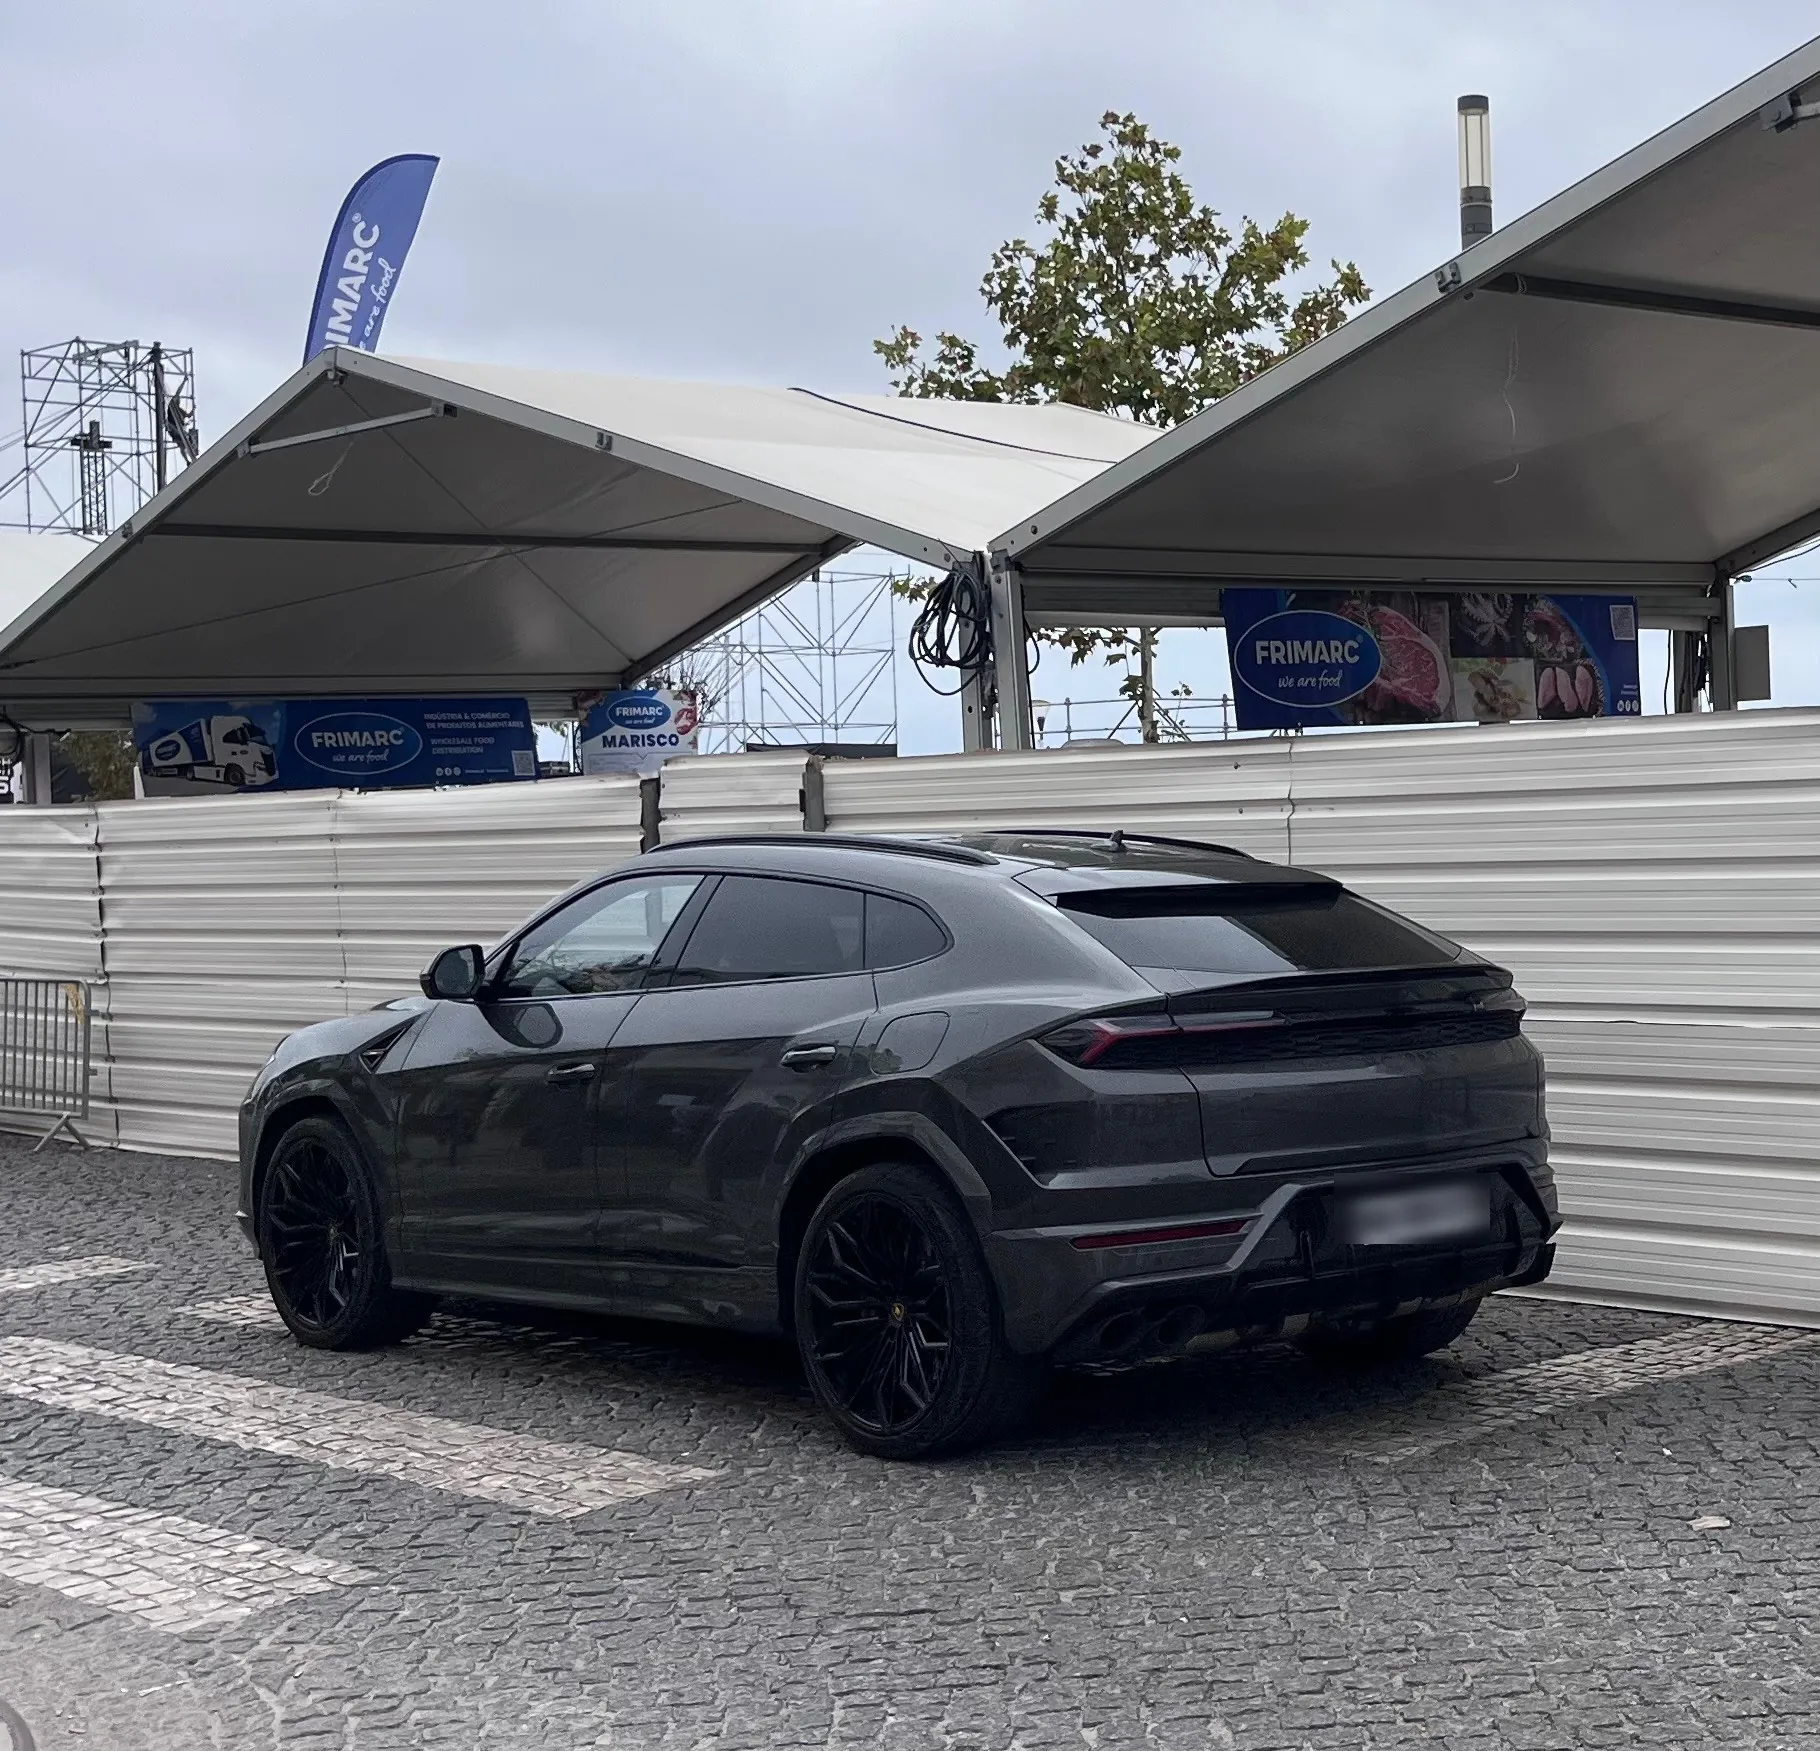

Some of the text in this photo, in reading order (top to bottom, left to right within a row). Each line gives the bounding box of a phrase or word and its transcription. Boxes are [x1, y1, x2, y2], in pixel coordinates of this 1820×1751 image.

[323, 220, 380, 349] IMARC
[370, 257, 397, 304] food
[364, 306, 381, 338] are
[1255, 639, 1360, 665] FRIMARC
[1278, 669, 1342, 690] we are food
[424, 712, 462, 720] INDÚSTRIA
[471, 711, 511, 720] COMÉRCIO
[616, 706, 663, 717] FRIMARC
[426, 721, 436, 730] DE
[438, 721, 477, 730] PRODUTOS
[311, 730, 404, 748] FRIMARC
[473, 736, 496, 745] FOOD
[602, 733, 680, 748] MARISCO
[332, 748, 390, 764] we are food
